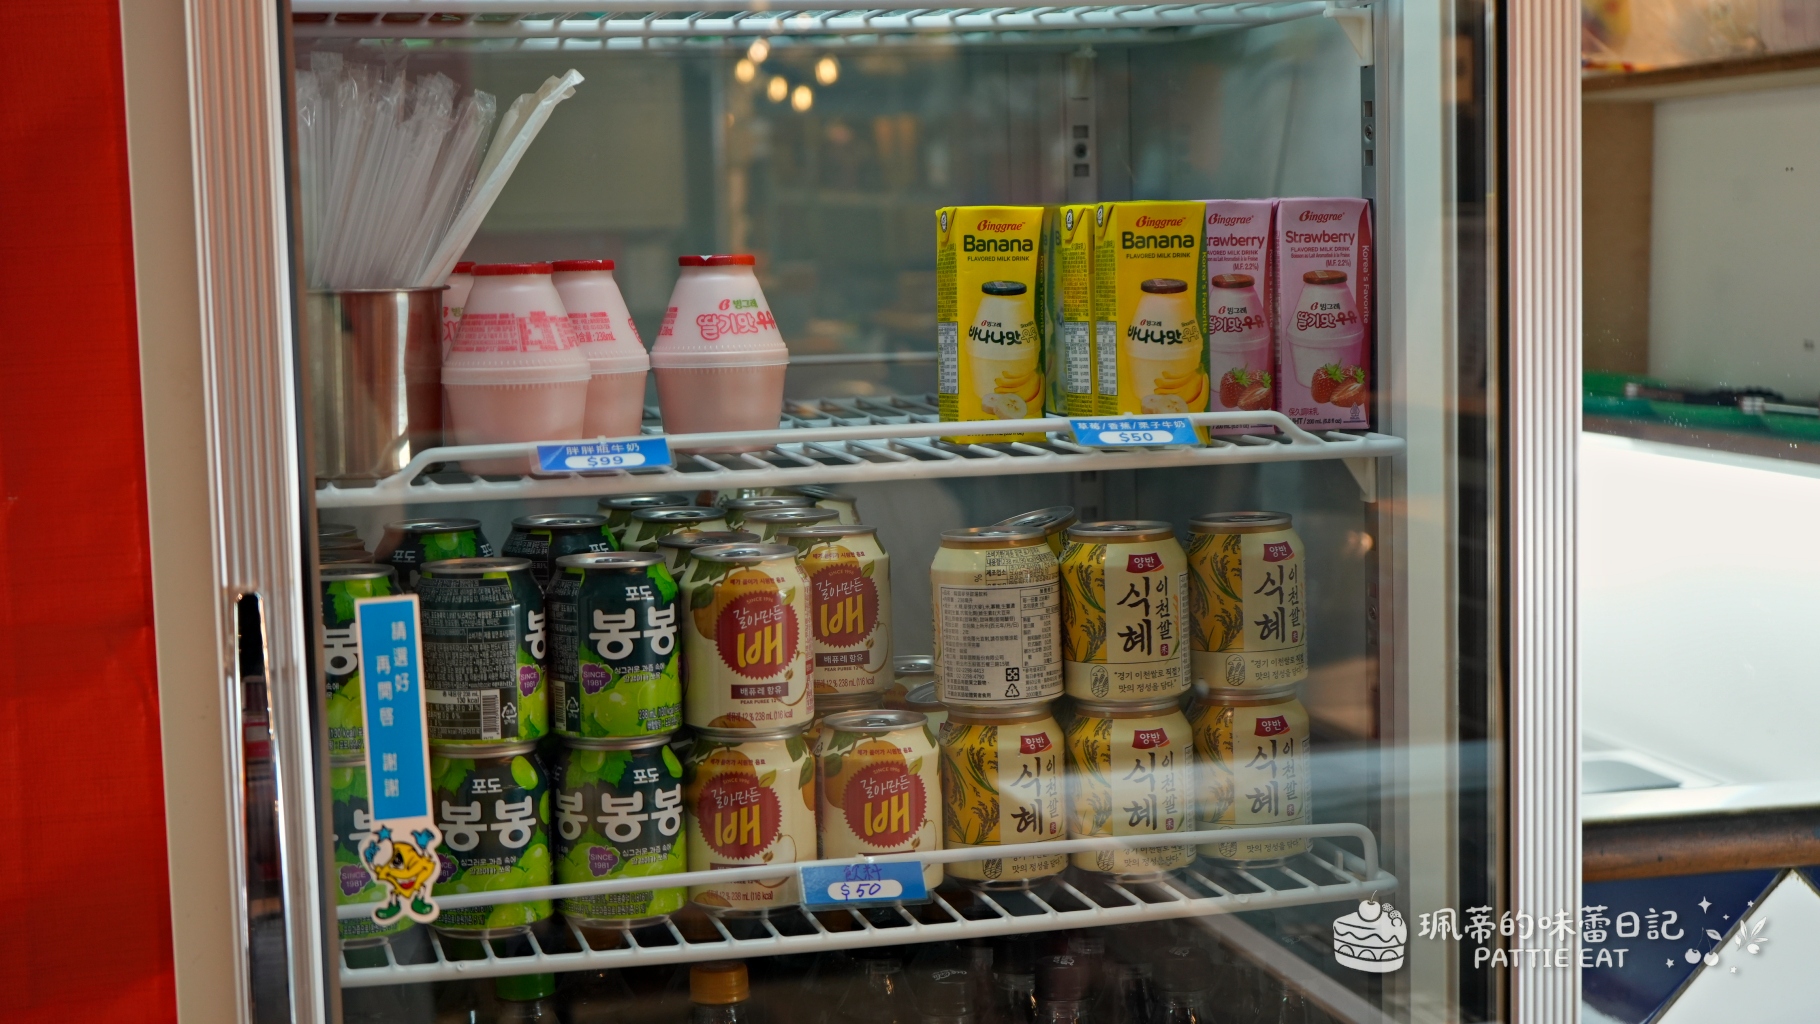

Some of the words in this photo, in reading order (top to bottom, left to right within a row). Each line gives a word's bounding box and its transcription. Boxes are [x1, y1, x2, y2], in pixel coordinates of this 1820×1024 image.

[1135, 215, 1183, 229] Binggrae
[1208, 213, 1252, 226] Binggrae
[1299, 210, 1343, 223] Binggrae
[977, 219, 1022, 232] Binggrae
[963, 234, 1033, 252] Banana
[1121, 231, 1195, 249] Banana
[1285, 230, 1355, 246] Strawberry
[733, 299, 757, 309] 빙그레
[1227, 307, 1247, 315] 빙그레
[1319, 303, 1341, 311] 빙그레
[1297, 310, 1357, 331] 딸기맛우유
[968, 325, 1038, 346] 바나나맛우유
[1127, 325, 1200, 345] 바나나맛우유
[1077, 420, 1186, 430] 草莓/香蕉/栗子牛奶
[1119, 432, 1153, 442] $50
[566, 443, 640, 455] 胖胖瓶牛奶
[587, 455, 624, 467] $99
[393, 550, 416, 563] 포도
[1269, 544, 1288, 558] 양반
[1134, 556, 1155, 569] 양반
[625, 586, 654, 601] 포도
[816, 577, 864, 601] 갈아만든
[1288, 564, 1301, 627] 이천쌀
[1155, 576, 1173, 640] 이천쌀
[1254, 565, 1286, 644] 식혜
[733, 604, 783, 630] 갈아만든
[820, 593, 864, 637] 배
[1117, 576, 1152, 656] 식혜
[589, 602, 677, 660] 봉봉
[737, 622, 783, 668] 배
[823, 655, 848, 664] 배퓨레
[849, 653, 864, 662] 함유
[614, 665, 640, 674] 싱그러운
[642, 663, 654, 672] 과즙
[1135, 669, 1165, 680] 이천쌀로
[1255, 671, 1270, 681] 맛의
[1272, 668, 1291, 679] 정성을
[839, 678, 848, 687] 238
[849, 678, 856, 686] mL
[1118, 684, 1134, 693] 맛의
[1137, 683, 1159, 693] 정성을
[740, 687, 765, 696] 배퓨레
[767, 685, 782, 695] 함유
[755, 711, 765, 721] 238
[766, 711, 773, 720] mL
[1261, 719, 1281, 732] 양반
[1026, 736, 1045, 750] 양반
[1140, 732, 1161, 746] 양반
[382, 752, 400, 798] 謝謝
[633, 768, 659, 784] 포도
[1281, 738, 1298, 801] 이천쌀
[1160, 751, 1178, 815] 이천쌀
[1245, 739, 1279, 818] 식혜
[471, 778, 501, 794] 포도
[860, 775, 911, 799] 갈아만든
[1045, 754, 1059, 819] 이천쌀
[1122, 752, 1158, 831] 식혜
[710, 786, 761, 809] 갈아만든
[1010, 756, 1044, 835] 식혜
[597, 783, 683, 843] 봉봉
[864, 792, 910, 837] 배
[439, 795, 536, 851] 봉봉
[714, 804, 761, 847] 배
[622, 848, 647, 857] 싱그러운
[650, 846, 661, 855] 과즙
[1246, 844, 1262, 853] 맛의
[1264, 841, 1285, 852] 정성을
[460, 858, 487, 866] 싱그러운
[488, 857, 502, 865] 과즙
[1012, 863, 1027, 874] 맛의
[1029, 860, 1049, 872] 정성을
[1124, 858, 1140, 868] 맛의
[1142, 857, 1164, 867] 정성을
[342, 872, 366, 880] SINCE
[731, 891, 741, 901] 238
[742, 891, 750, 900] mL
[750, 891, 761, 901] (116
[840, 883, 881, 901] $50
